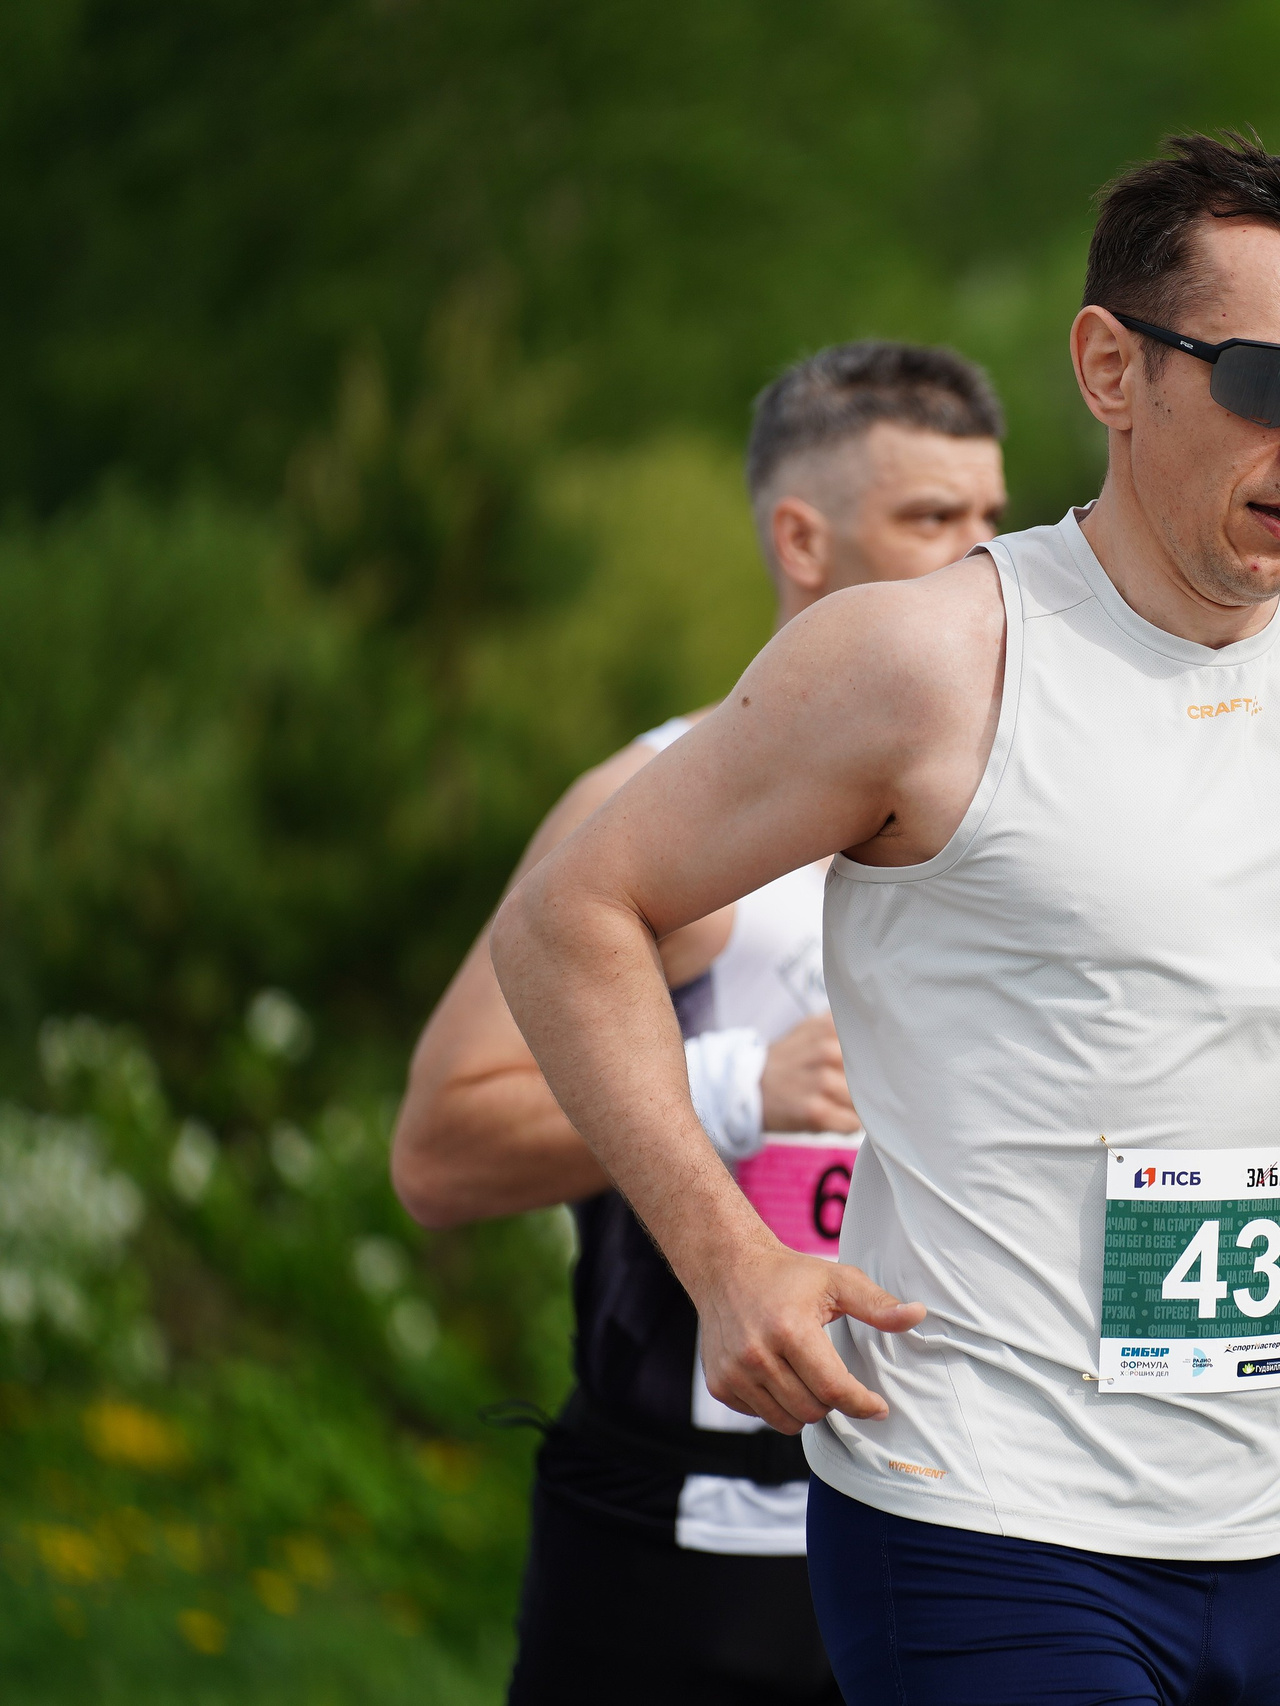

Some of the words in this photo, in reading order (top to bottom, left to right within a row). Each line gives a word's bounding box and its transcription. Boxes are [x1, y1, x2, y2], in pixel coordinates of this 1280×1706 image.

[1187, 698, 1253, 720] CRAFT
[1161, 1171, 1201, 1186] ПСБ
[813, 1165, 851, 1240] 6
[1131, 1200, 1177, 1213] ВЫБЕГАЮ
[1178, 1201, 1191, 1213] ЗА
[1192, 1201, 1222, 1213] РАМКИ
[1153, 1218, 1166, 1231] НА
[1126, 1235, 1144, 1248] БЕГ
[1145, 1235, 1152, 1248] В
[1153, 1235, 1177, 1248] СЕБЕ
[1119, 1252, 1153, 1268] ДАВНО
[1226, 1270, 1238, 1284] НА
[1154, 1306, 1190, 1320] СТРЕСС
[1147, 1324, 1186, 1338] ФИНИШ
[1197, 1323, 1230, 1337] ТОЛЬКО
[1231, 1321, 1262, 1336] НАЧАЛО
[1120, 1347, 1170, 1357] СИБУР
[1120, 1360, 1169, 1369] ФОРМУЛА
[888, 1459, 947, 1480] HYPERVENT
